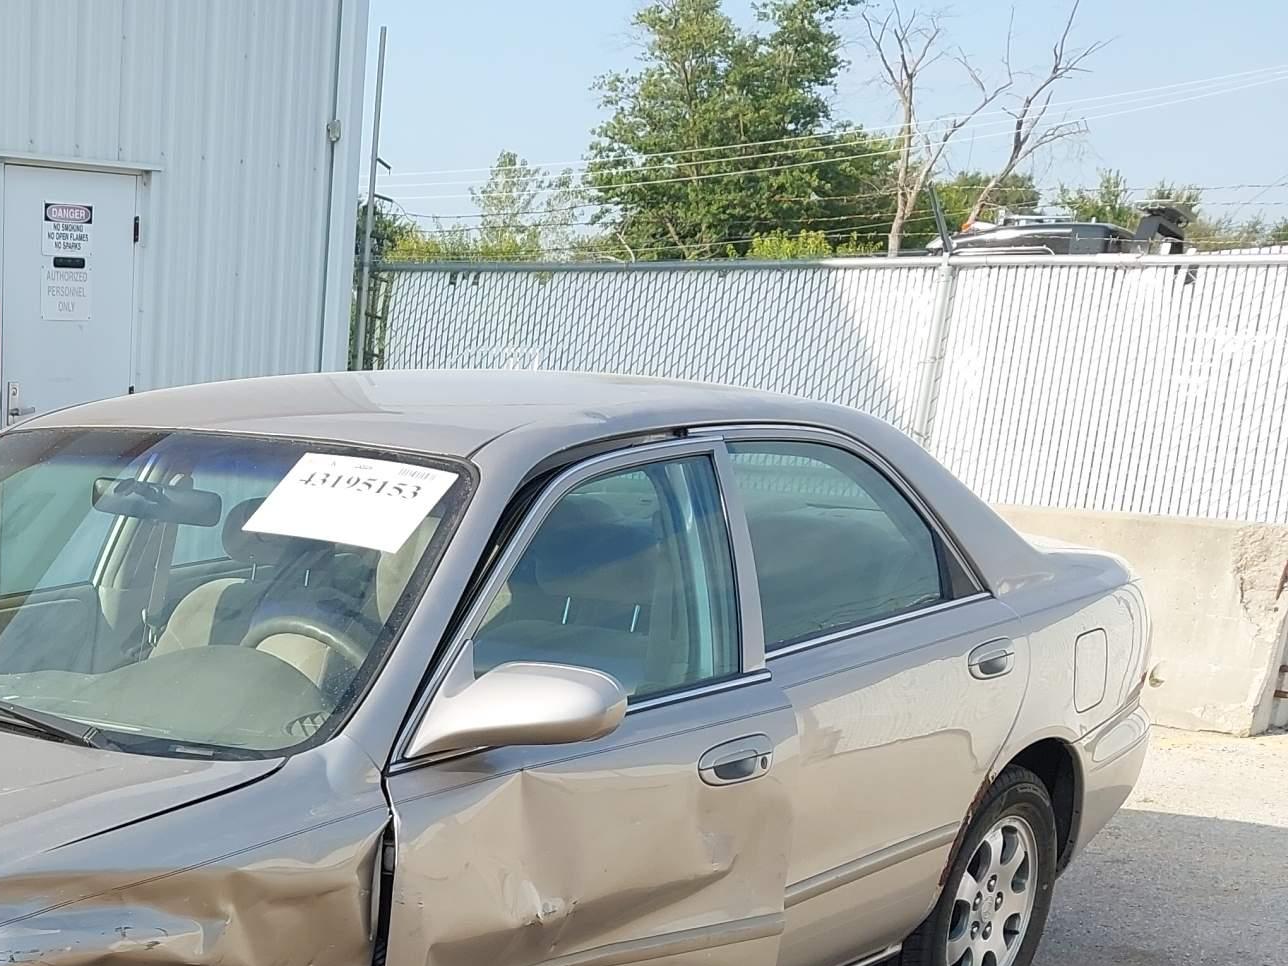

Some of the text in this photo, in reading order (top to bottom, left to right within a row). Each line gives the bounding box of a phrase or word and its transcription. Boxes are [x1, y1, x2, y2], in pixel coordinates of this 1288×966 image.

[51, 207, 86, 220] DANGER
[53, 223, 84, 233] NO SMOKING
[47, 232, 89, 242] NO OPEN FLAMES
[54, 241, 82, 250] NO SPARKS
[46, 270, 88, 282] AUTHORIZED
[47, 285, 87, 298] PERSONNEL
[58, 300, 75, 312] ONLY
[298, 471, 422, 500] 43195153
